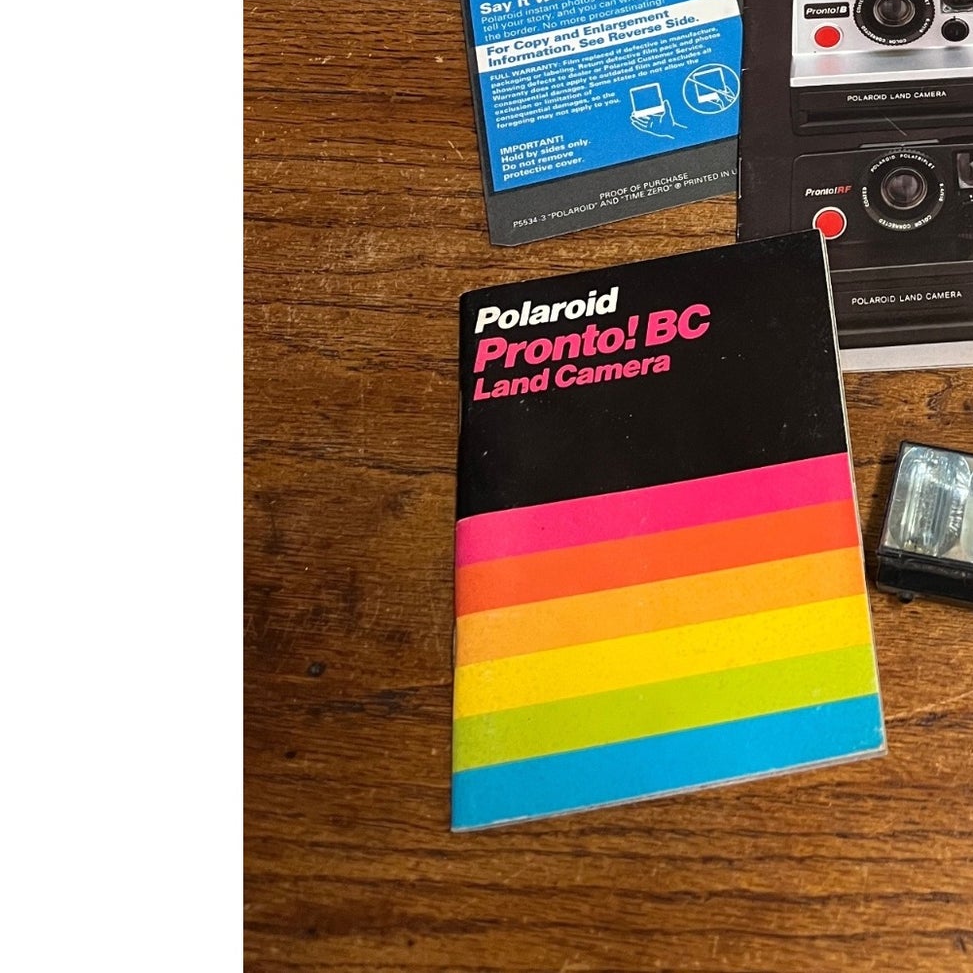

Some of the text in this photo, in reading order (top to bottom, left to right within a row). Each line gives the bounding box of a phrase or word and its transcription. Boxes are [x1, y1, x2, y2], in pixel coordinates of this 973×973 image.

[479, 0, 511, 14] Say
[481, 9, 522, 23] Polaroid
[525, 3, 558, 15] instant
[483, 23, 498, 32] tell
[500, 19, 523, 29] your
[557, 7, 575, 16] and
[578, 4, 596, 13] you
[599, 0, 616, 7] can
[484, 33, 500, 41] the
[560, 16, 585, 25] more
[486, 10, 669, 55] For Copy and Enlargement
[488, 15, 698, 67] Information, See Reverse Side.
[890, 92, 911, 100] LAND
[500, 135, 564, 155] IMPORTANT!
[501, 152, 523, 162] Hold
[540, 144, 565, 154] sides
[567, 138, 590, 148] only.
[502, 151, 573, 171] Do not remove
[503, 157, 581, 181] protective cover.
[599, 172, 688, 199] PROOF OF PURCHASE
[599, 196, 618, 207] AND
[683, 172, 718, 186] PRINTED
[474, 287, 619, 334] Polaroid
[852, 291, 962, 305] POLAROID LAND CAMERA
[473, 304, 711, 373] Pronto! BC
[473, 355, 670, 401] Land Camera
